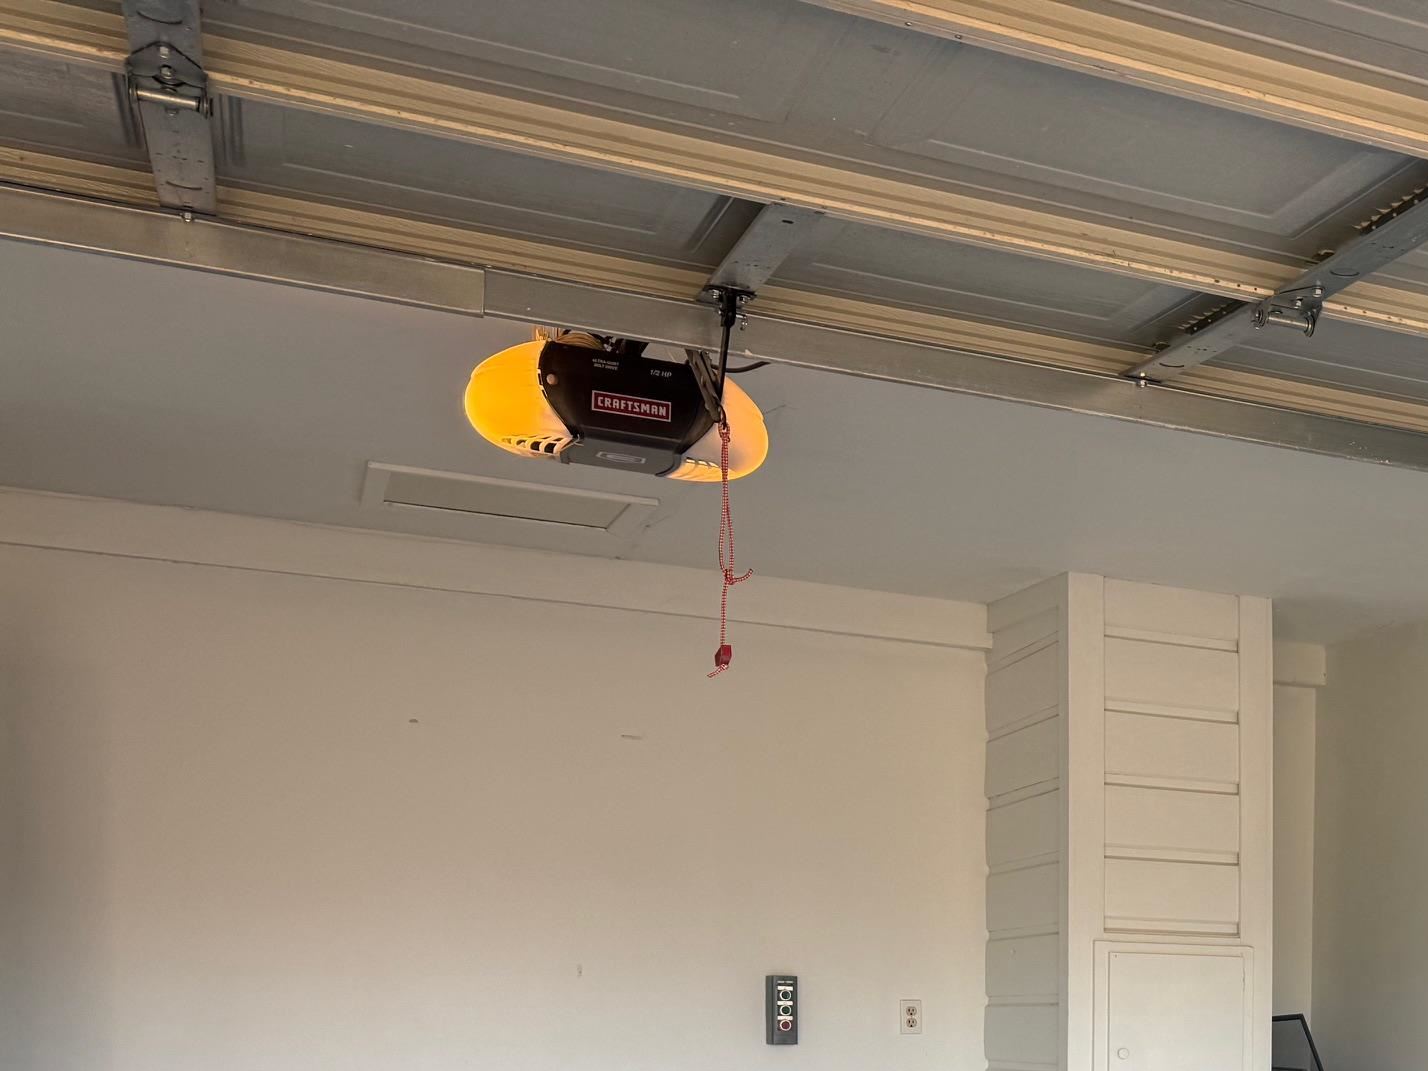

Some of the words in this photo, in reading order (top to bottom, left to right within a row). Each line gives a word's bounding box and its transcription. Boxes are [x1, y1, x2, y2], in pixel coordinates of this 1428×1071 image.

[650, 369, 661, 377] 1/2
[661, 370, 672, 378] HP
[597, 396, 667, 417] CRAFTSMAN
